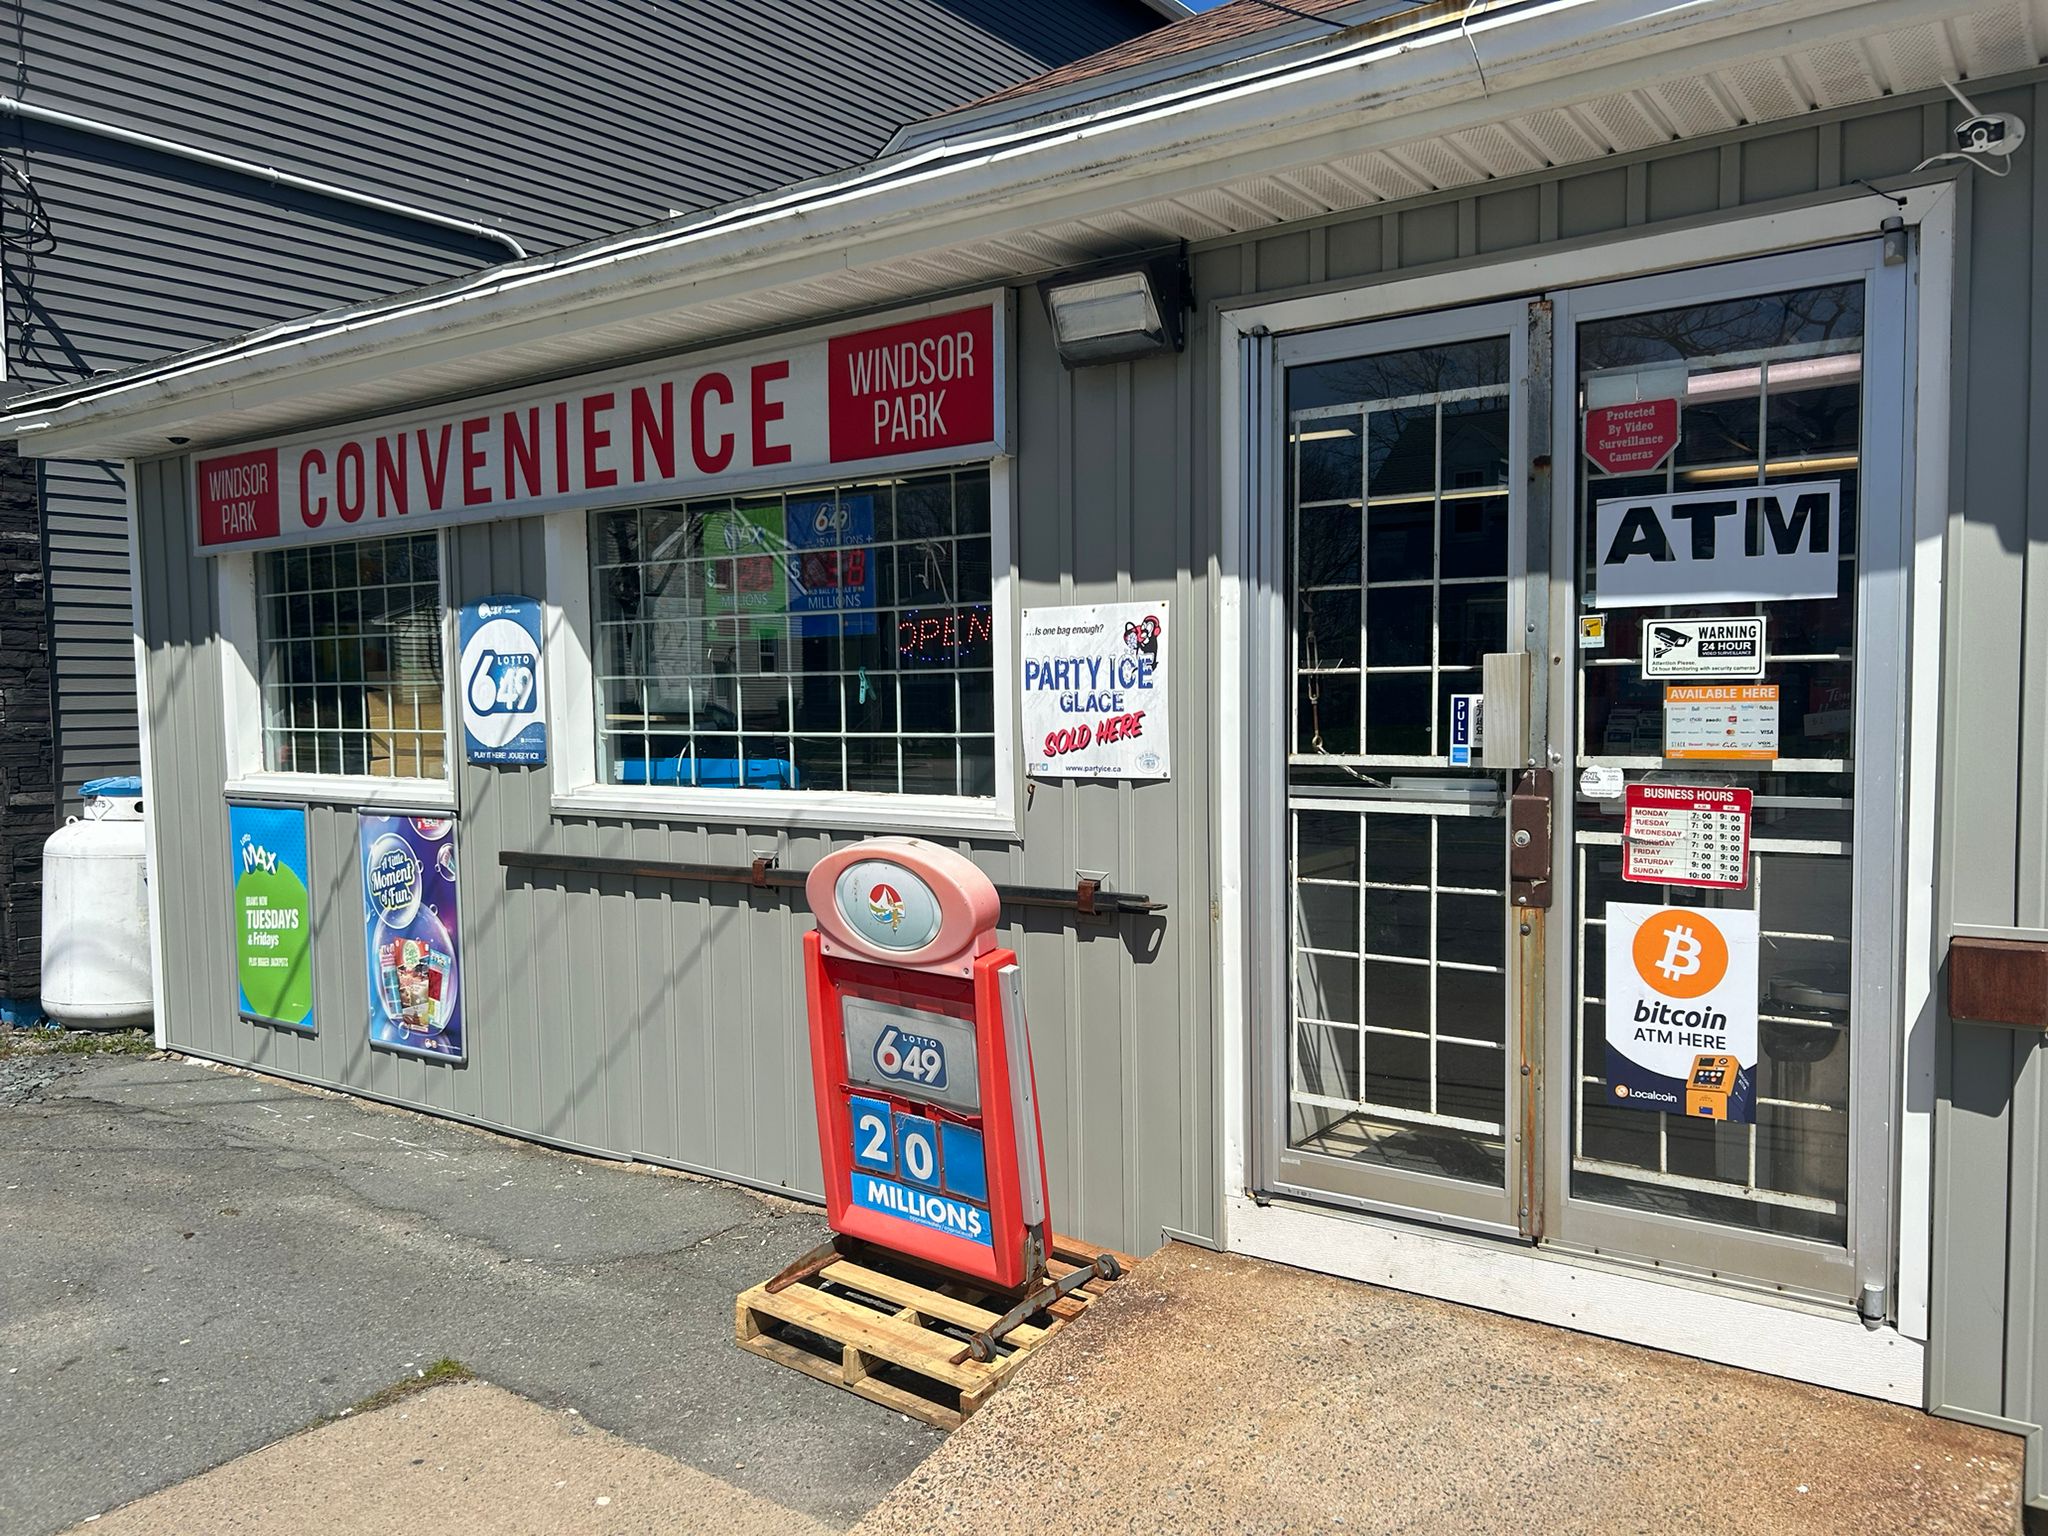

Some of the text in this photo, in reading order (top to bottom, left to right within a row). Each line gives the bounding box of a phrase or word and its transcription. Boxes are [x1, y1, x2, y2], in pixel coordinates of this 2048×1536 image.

[848, 331, 974, 397] WINDSOR
[873, 389, 948, 445] PARK
[1606, 406, 1656, 421] Protected
[1608, 421, 1654, 437] By Video
[300, 360, 791, 528] CONVENIENCE
[1599, 435, 1664, 450] Surveillance
[1609, 450, 1654, 463] Cameras
[209, 463, 268, 502] WINDSOR
[222, 500, 257, 535] PARK
[1604, 493, 1830, 565] ATM
[899, 612, 992, 652] OPEN
[1057, 626, 1070, 637] bag
[1071, 624, 1104, 637] enough?
[1698, 625, 1757, 639] WARNING
[1702, 641, 1752, 651] 24 HOUR
[497, 655, 530, 666] LOTTO
[1025, 654, 1153, 691] PARTY ICE
[471, 655, 534, 712] 649
[1060, 690, 1125, 713] GLACE
[1670, 687, 1776, 700] AVAILABLE HERE
[1457, 700, 1466, 741] PULL
[1043, 710, 1147, 758] SOLD HERE
[1065, 763, 1122, 773] www.partyice.ca
[1643, 787, 1734, 802] BUSINESS HOURS
[1635, 809, 1669, 817] MONDAY
[1635, 819, 1669, 827] TUESDAY
[1634, 828, 1682, 837] WEDNESDAY
[242, 842, 277, 875] MAX
[387, 852, 404, 870] Little
[1633, 848, 1661, 856] FRIDAY
[1633, 857, 1674, 866] SATURDAY
[372, 862, 411, 891] Moment
[1632, 867, 1664, 875] SUNDAY
[381, 886, 411, 906] of Fun.
[246, 908, 299, 930] TUESDAYS
[253, 931, 280, 949] Fridays
[1633, 999, 1727, 1031] bitcoin
[902, 1033, 937, 1048] LOTTO
[1633, 1027, 1727, 1050] ATM HERE
[877, 1030, 942, 1083] 649
[1629, 1088, 1678, 1104] Localcoin
